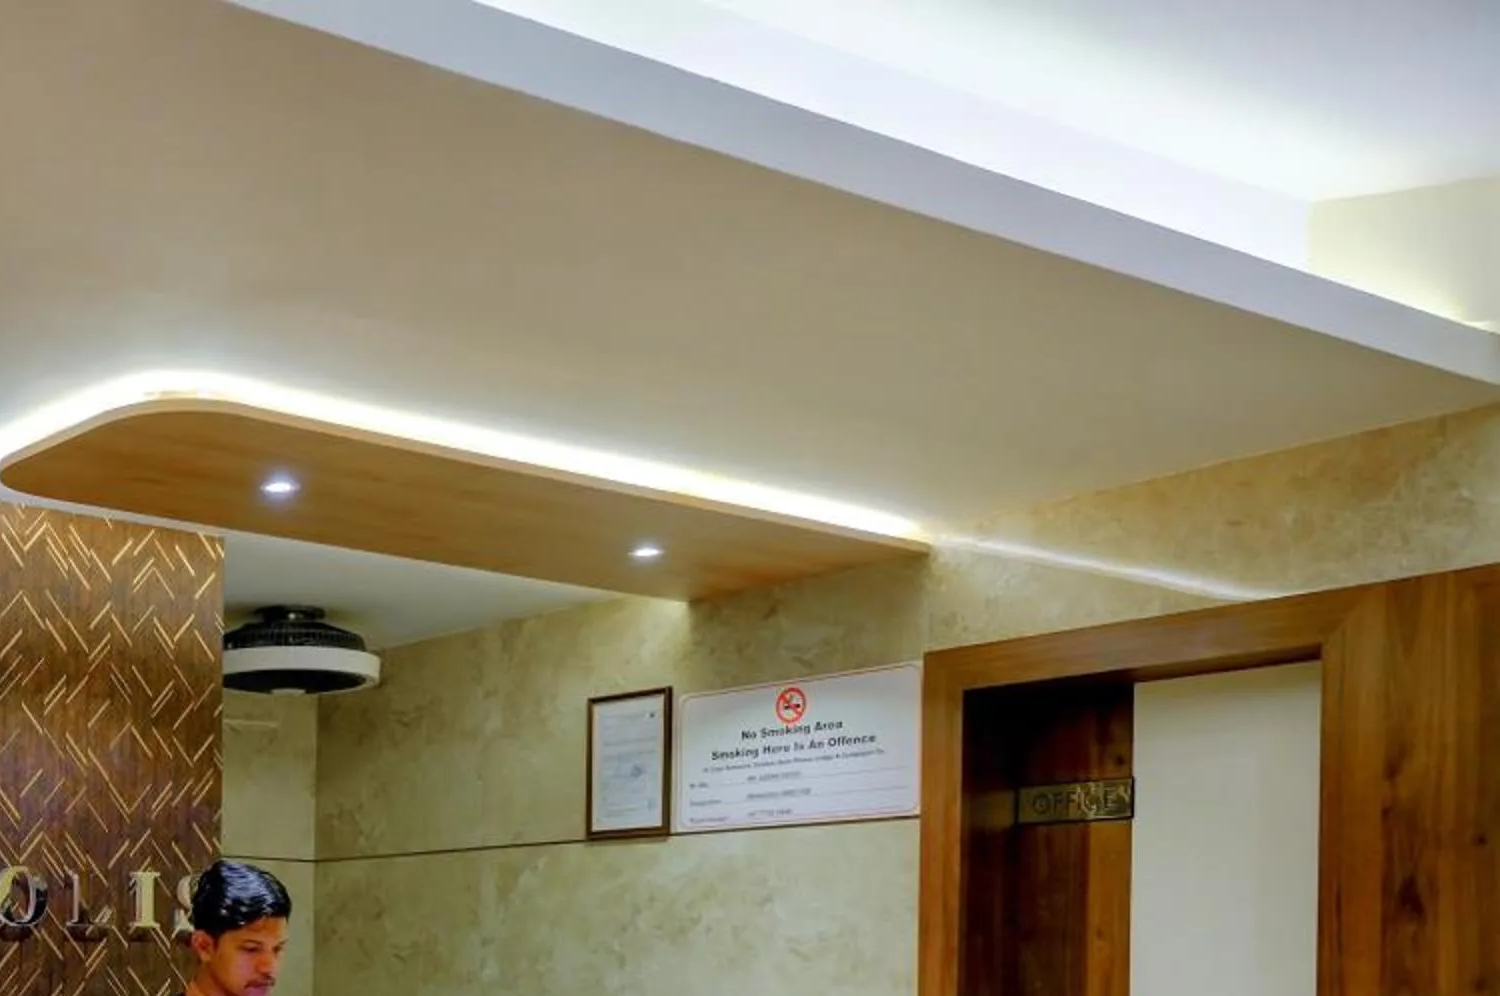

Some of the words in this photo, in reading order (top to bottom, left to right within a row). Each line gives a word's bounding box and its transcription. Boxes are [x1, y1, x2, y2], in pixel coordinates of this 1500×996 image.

[742, 731, 757, 741] No
[760, 725, 811, 738] Smoking
[814, 720, 843, 731] Area
[711, 745, 759, 760] Smoking
[763, 743, 791, 754] Here
[809, 739, 824, 749] An
[828, 734, 877, 747] Offence
